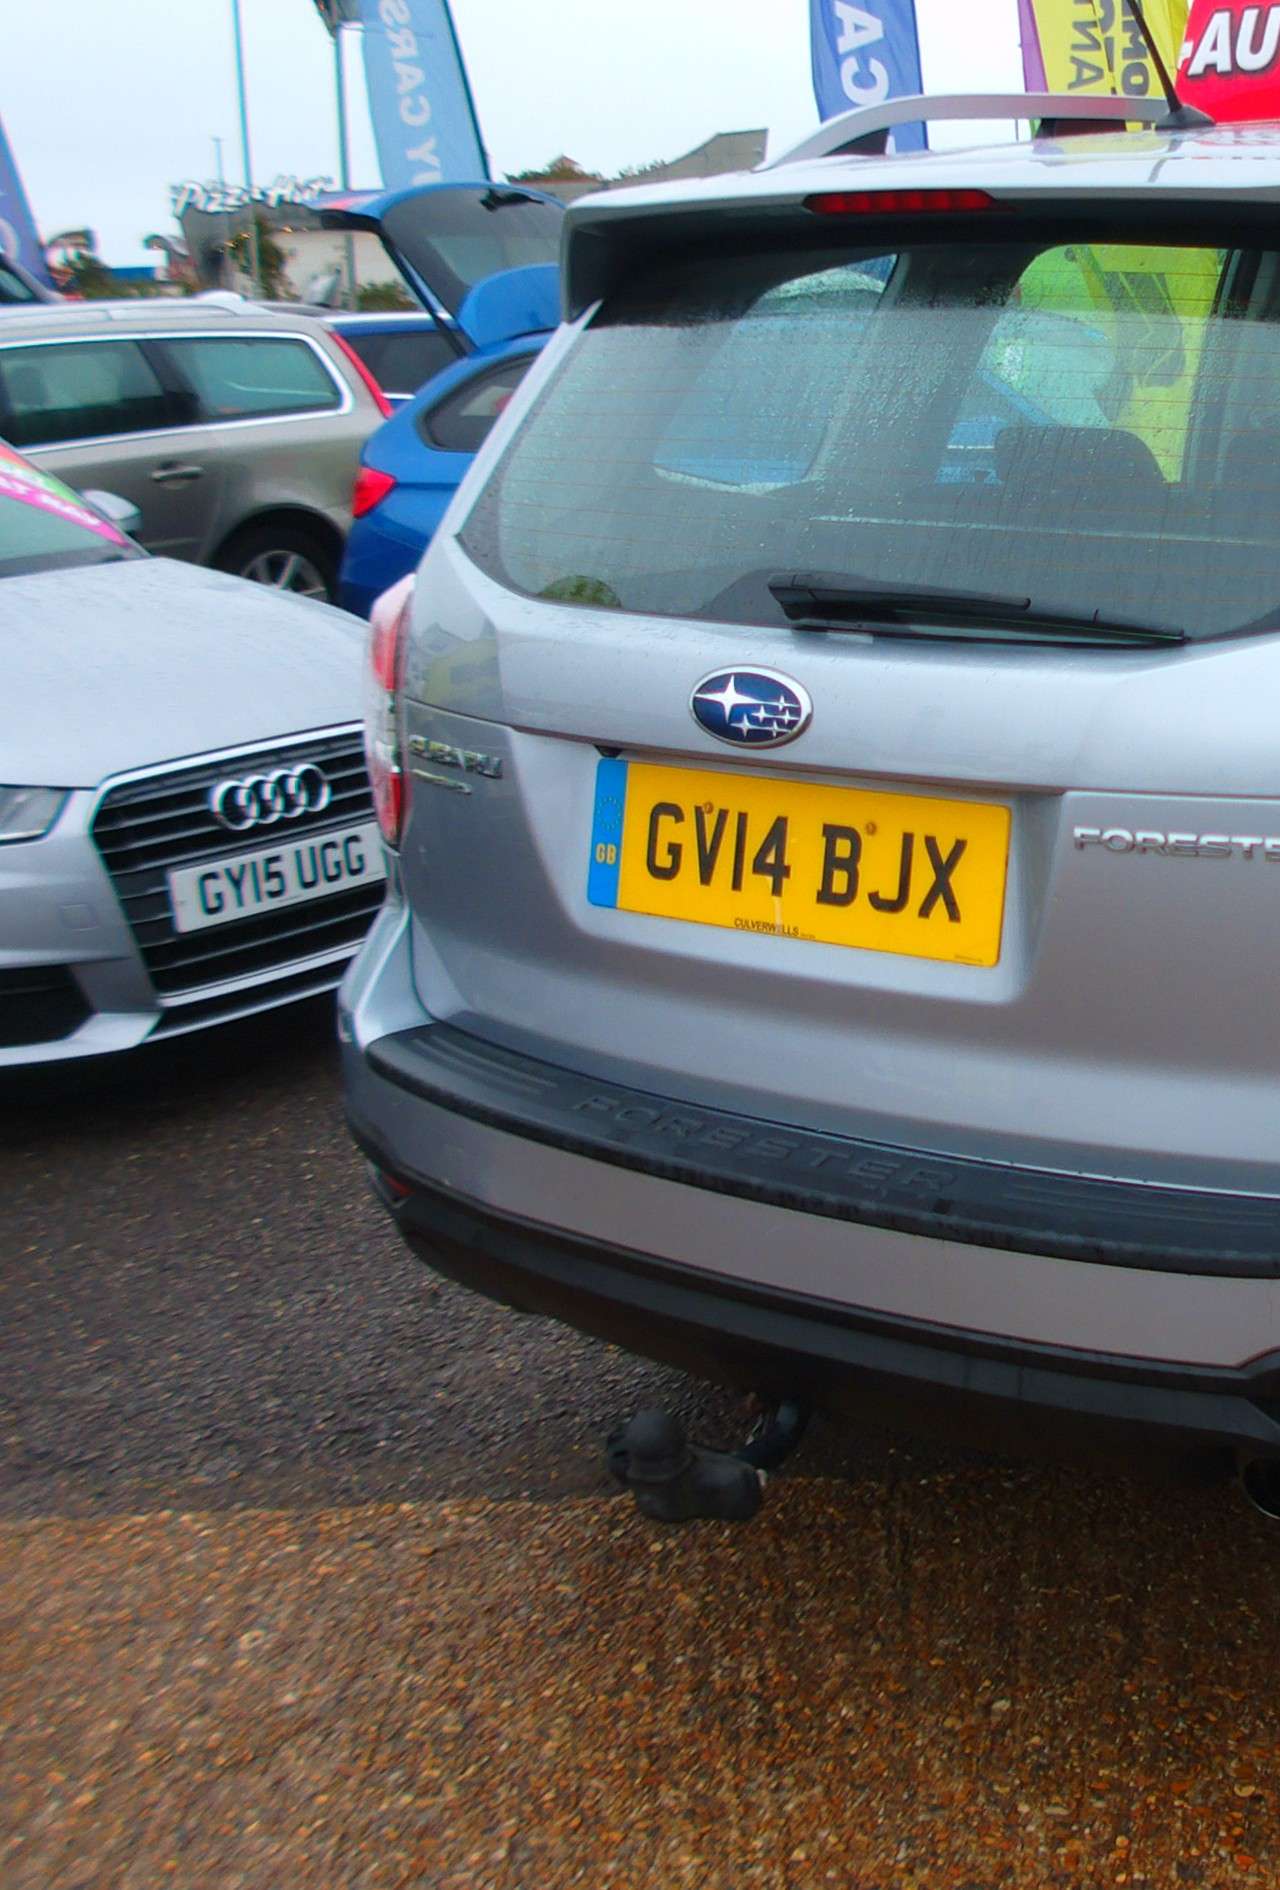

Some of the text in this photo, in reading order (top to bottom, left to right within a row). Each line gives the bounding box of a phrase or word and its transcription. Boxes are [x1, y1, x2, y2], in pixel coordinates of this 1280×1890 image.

[199, 835, 366, 915] GY15 UGG
[594, 843, 617, 865] GB
[646, 801, 968, 923] GV14 BJX
[573, 1094, 957, 1191] FORESTER
